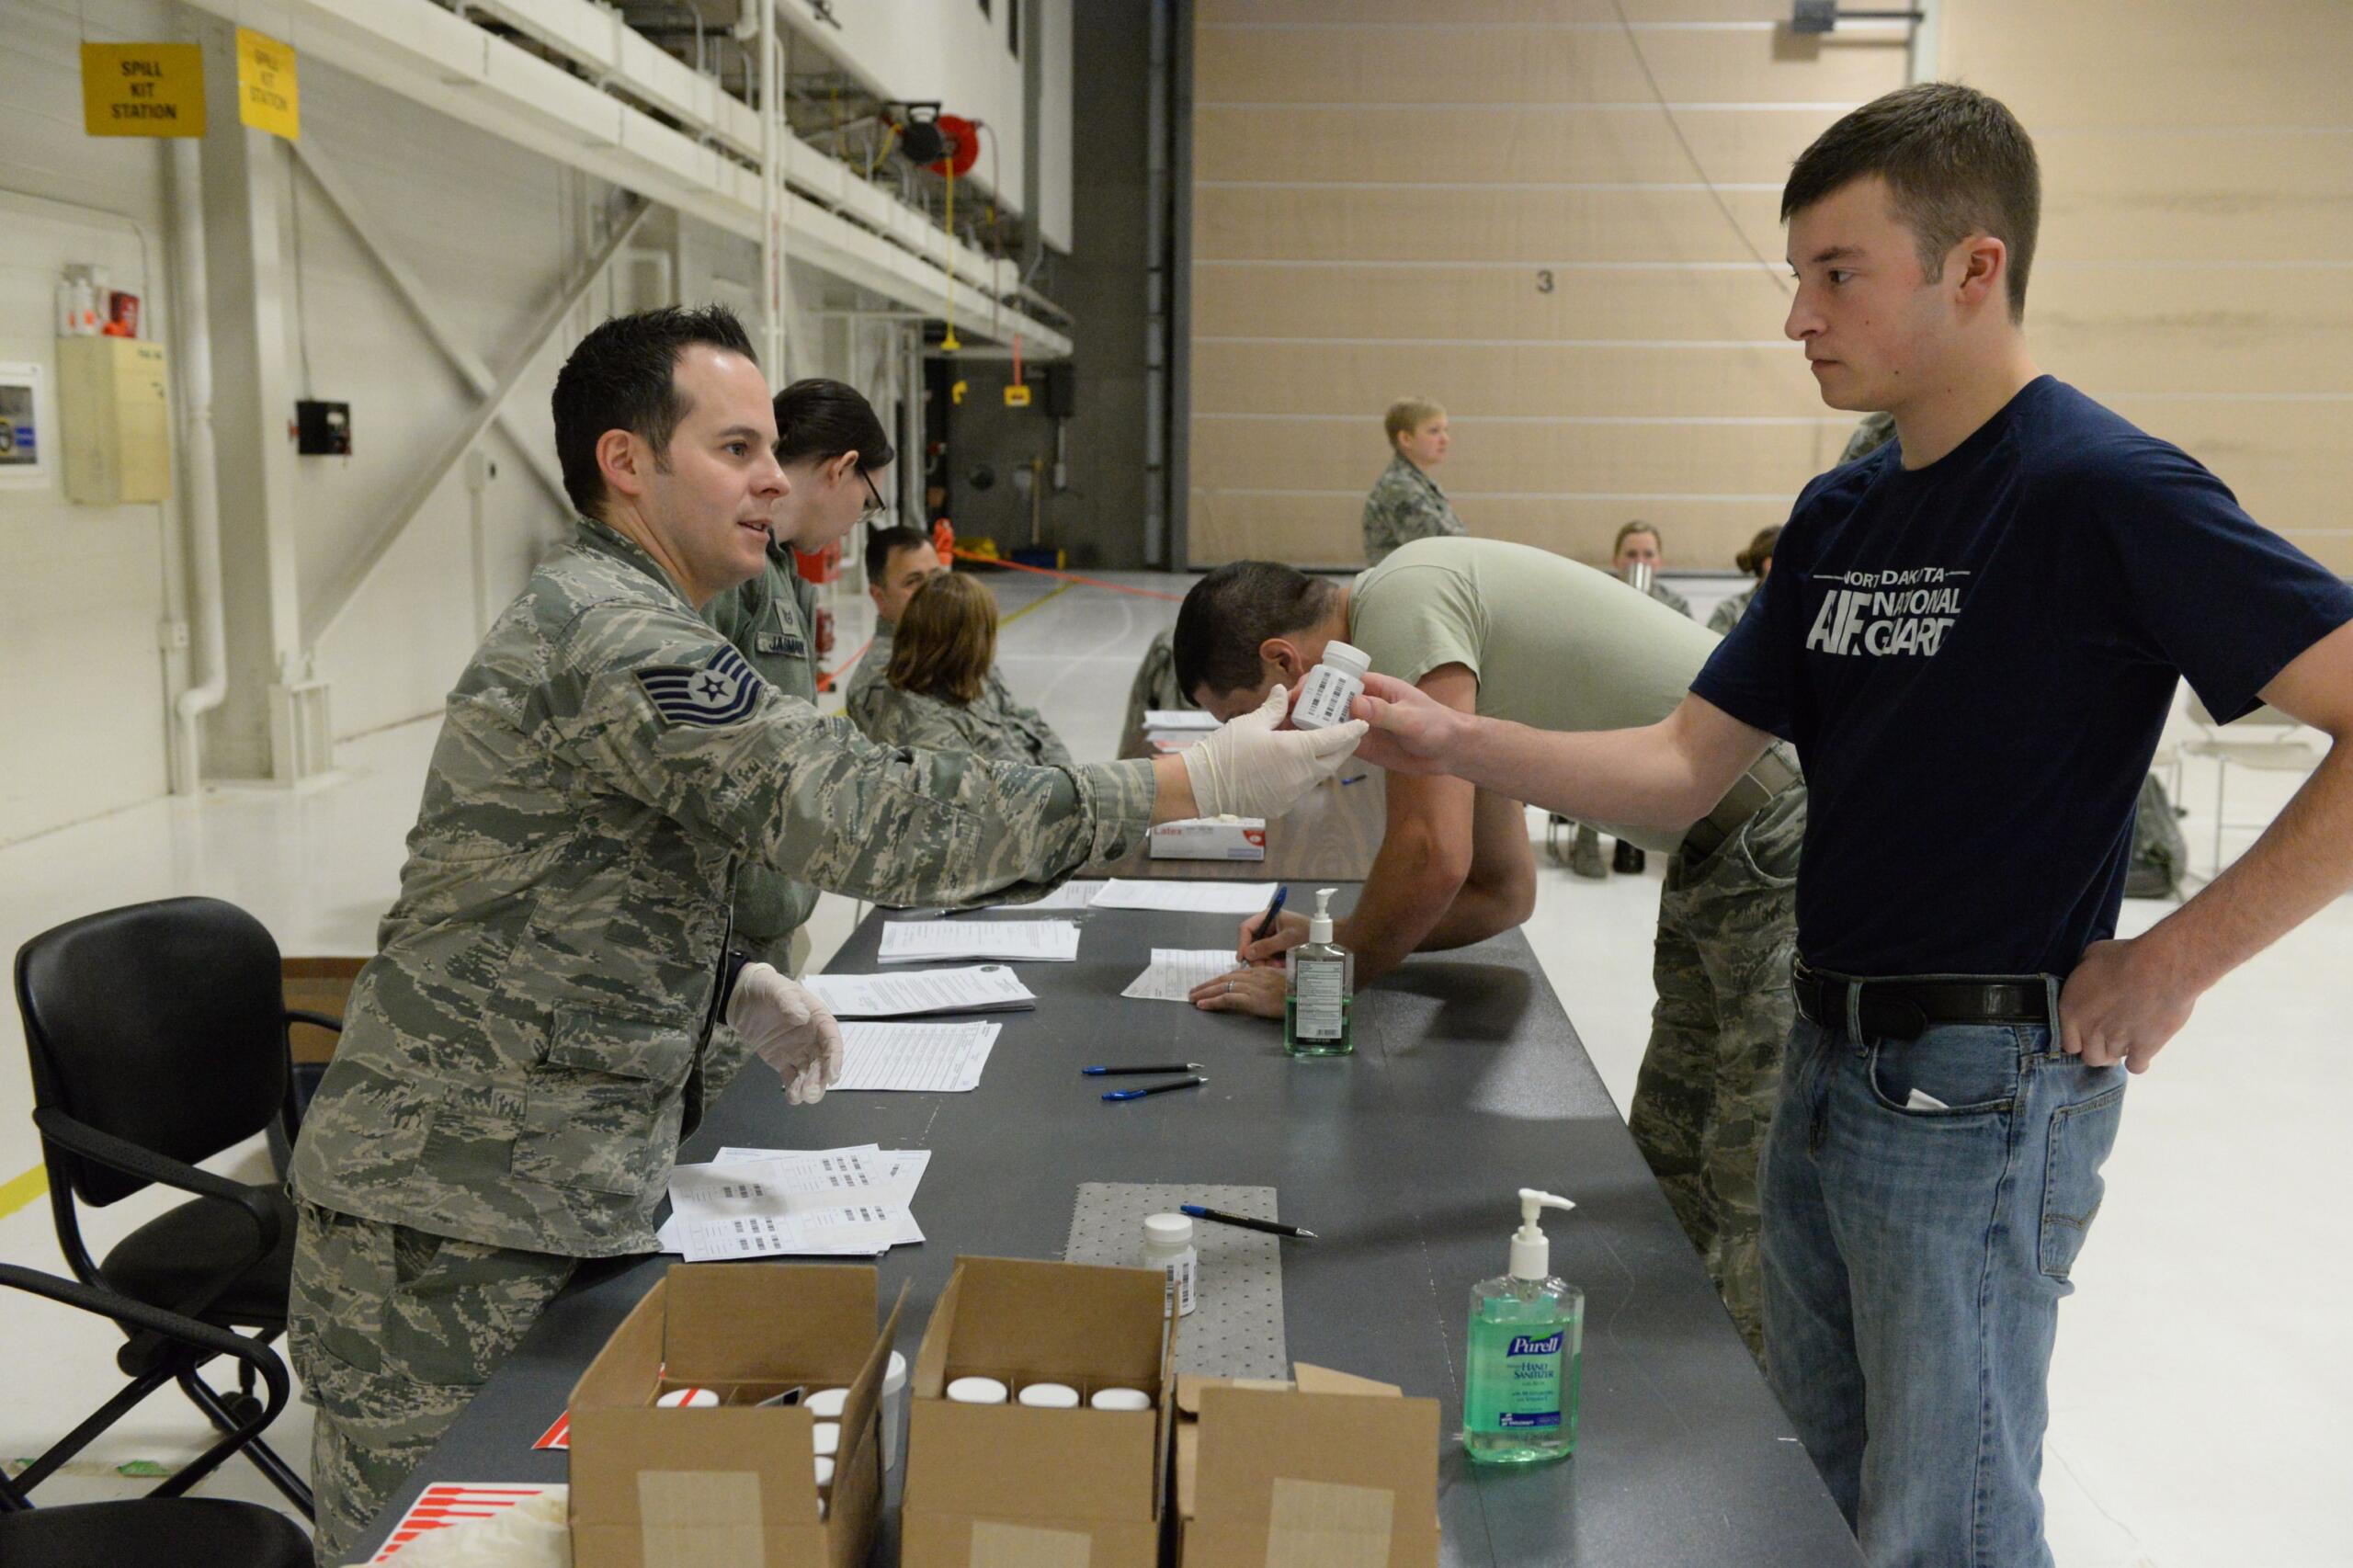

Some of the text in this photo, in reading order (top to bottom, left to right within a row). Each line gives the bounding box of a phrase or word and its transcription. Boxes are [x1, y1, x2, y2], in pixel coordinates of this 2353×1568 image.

[120, 61, 163, 77] SPILL
[130, 82, 154, 97] KIT
[111, 103, 177, 119] STATION
[1537, 269, 1554, 294] 3
[1844, 567, 1945, 588] NORT DAKTA
[1871, 587, 1961, 617] NATONAL
[1514, 1337, 1559, 1353] Purell
[1522, 1362, 1548, 1371] HAND
